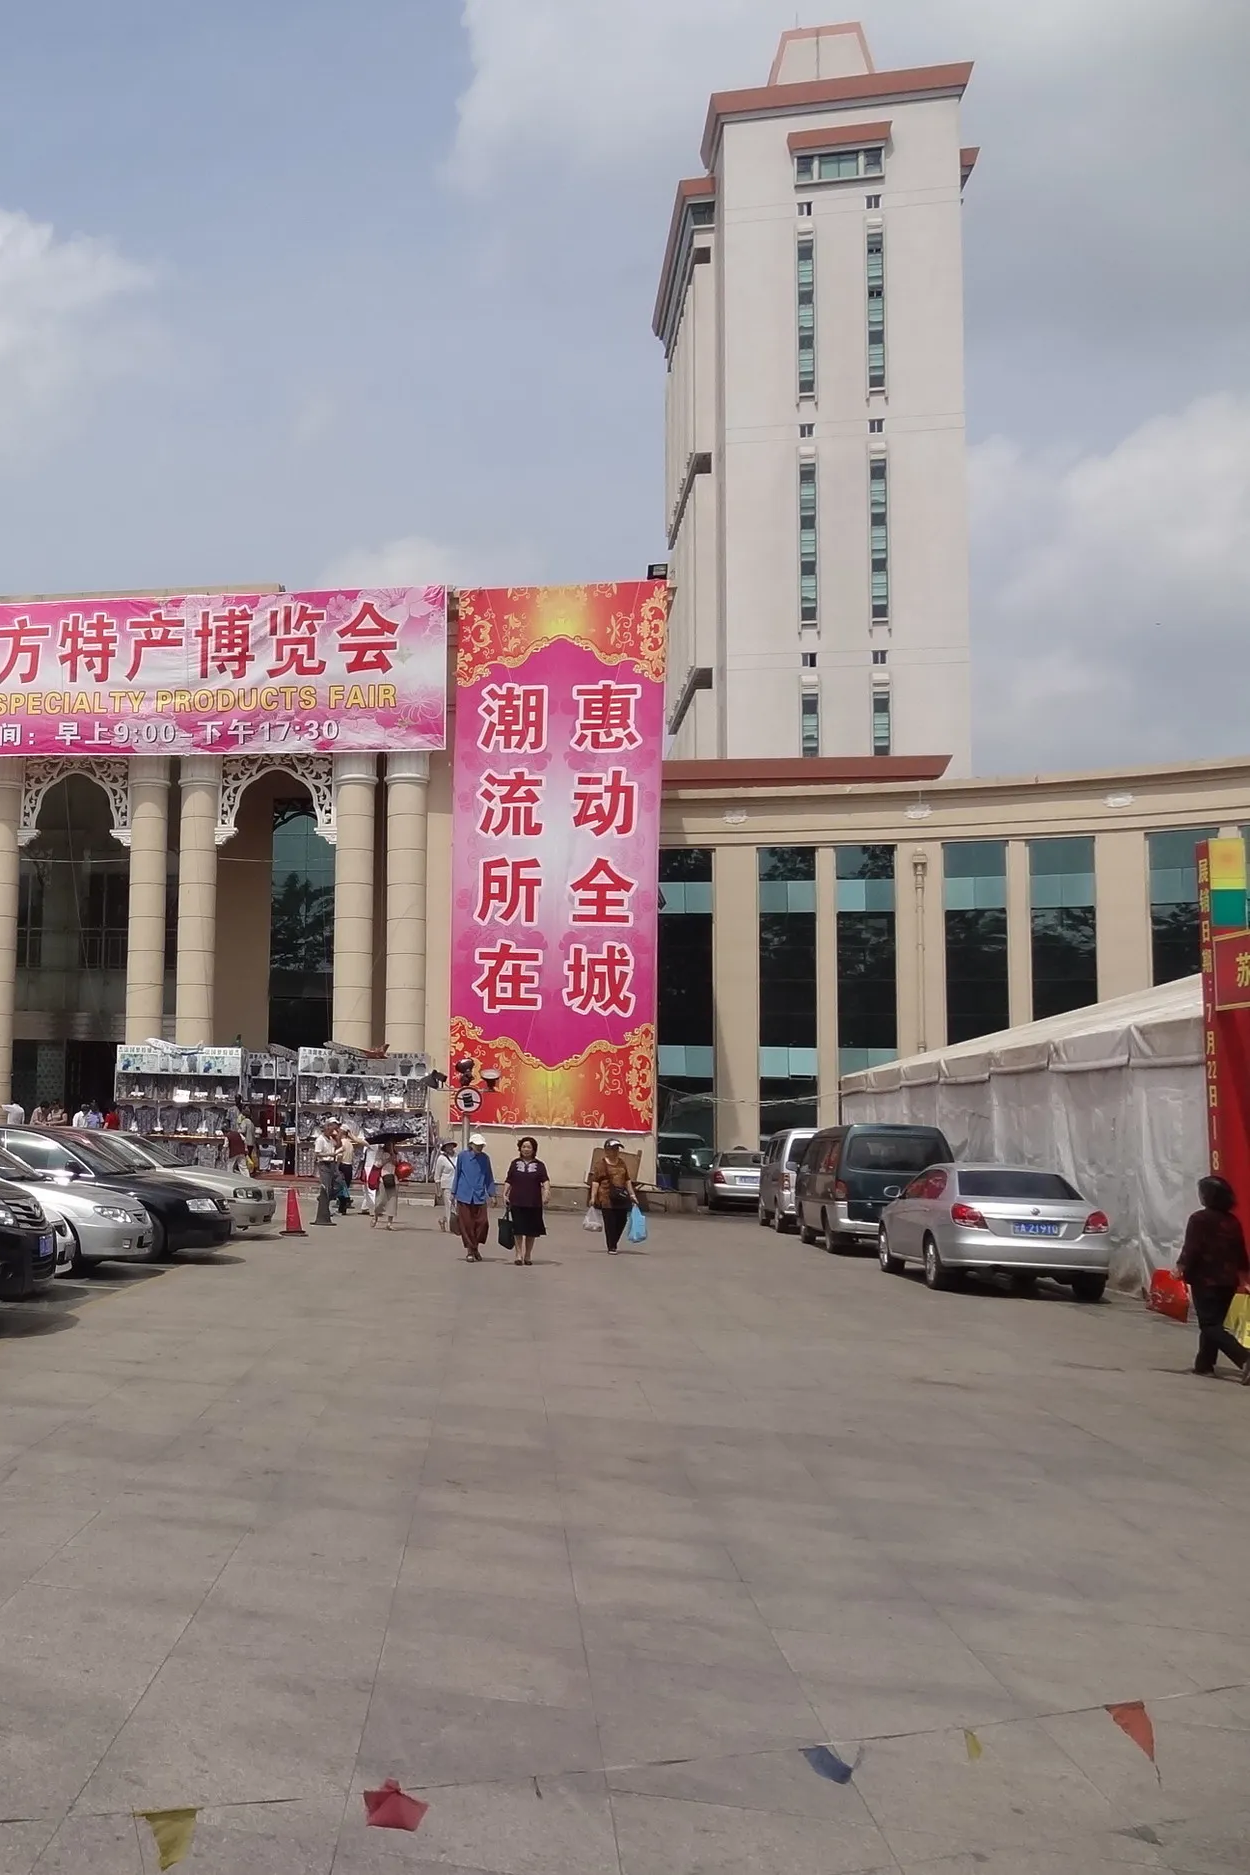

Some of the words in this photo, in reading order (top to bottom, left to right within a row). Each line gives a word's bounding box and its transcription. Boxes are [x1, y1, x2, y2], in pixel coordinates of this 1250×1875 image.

[155, 686, 318, 714] PRODUCTS
[329, 683, 397, 710] FAIR
[471, 681, 549, 1014] 潮流所在
[562, 680, 642, 1018] 惠动全城
